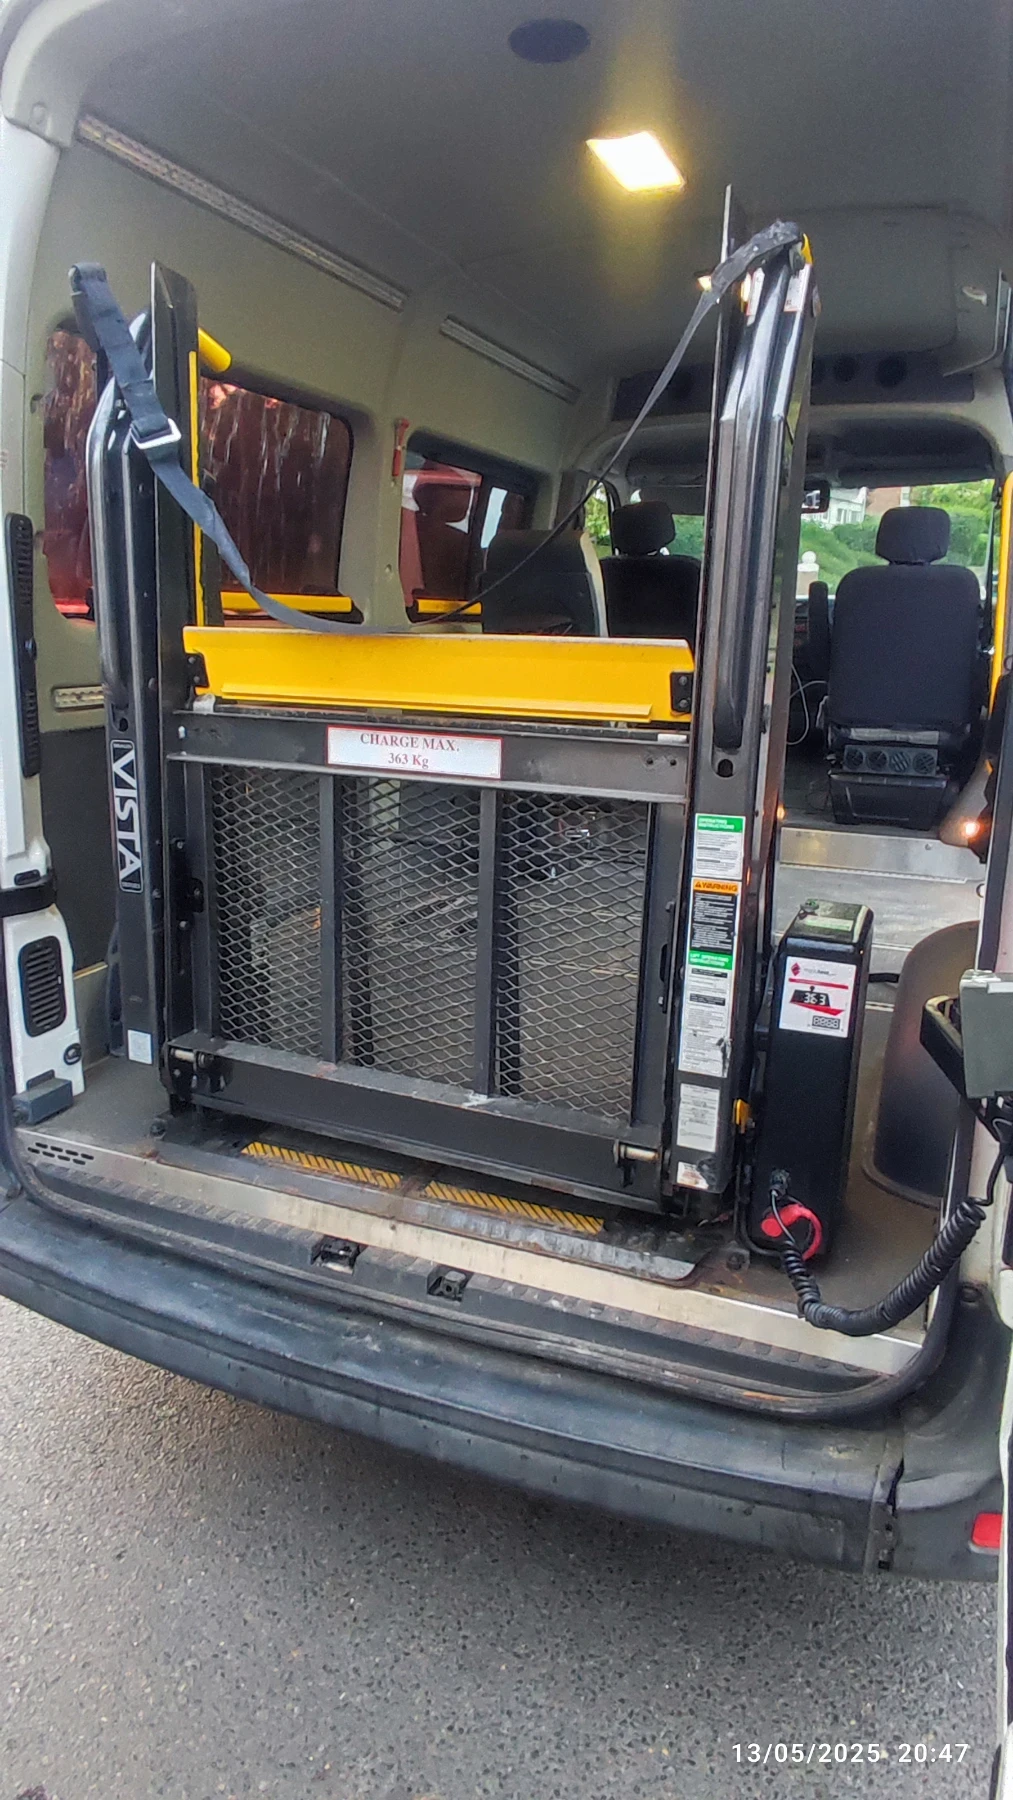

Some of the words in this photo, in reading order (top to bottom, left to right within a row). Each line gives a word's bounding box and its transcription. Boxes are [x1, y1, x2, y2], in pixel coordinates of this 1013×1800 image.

[360, 732, 419, 749] CHARGE
[422, 739, 460, 752] MAX.
[388, 752, 409, 765] 363
[412, 755, 429, 769] Kg
[113, 750, 142, 879] VISTA
[702, 882, 738, 892] WARNING
